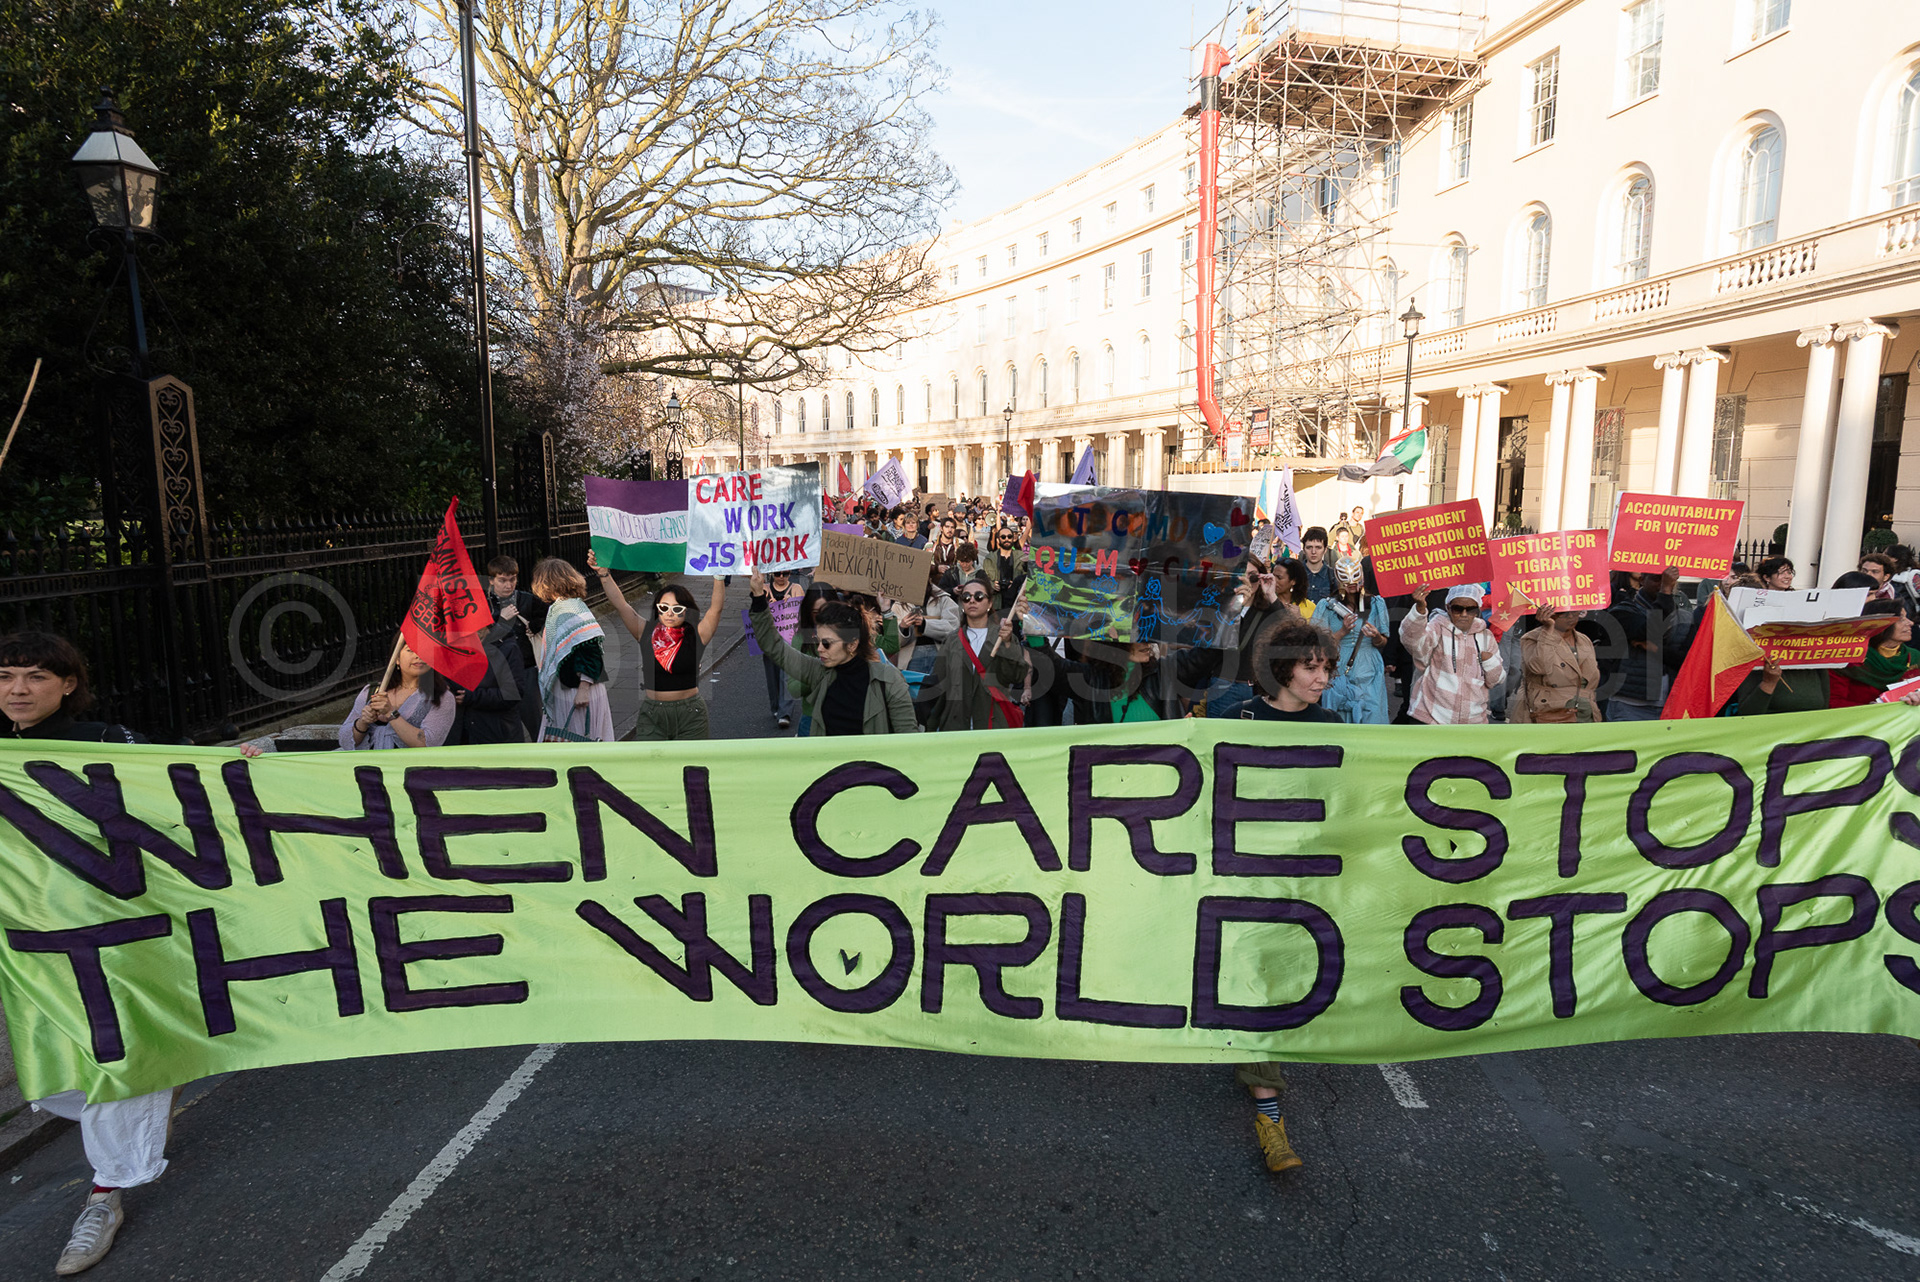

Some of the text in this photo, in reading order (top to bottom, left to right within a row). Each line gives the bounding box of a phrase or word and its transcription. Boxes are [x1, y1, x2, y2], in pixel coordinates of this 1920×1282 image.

[695, 473, 763, 504] CARE
[590, 508, 613, 536] STOP
[612, 511, 659, 540] VIOLENCE
[724, 501, 796, 534] WORK
[1380, 509, 1466, 538] INDEPENDENT
[1625, 502, 1736, 521] ACCOUNTABILITY
[1371, 525, 1483, 557] INVESTIGATION OF
[1634, 519, 1719, 537] FOR VICTIMS
[708, 533, 810, 568] IS WORK
[825, 533, 850, 555] today
[858, 539, 879, 561] fight
[883, 542, 897, 562] for
[898, 552, 915, 569] my
[1376, 542, 1487, 573] SEXUAL VIOLENCE
[1498, 533, 1597, 558] JUSTICE FOR
[1664, 538, 1683, 551] OF
[823, 551, 887, 580] MEXICAN
[1403, 563, 1465, 585] IN TIGRAY
[1515, 555, 1583, 575] TIGRAY'S
[1612, 550, 1729, 571] SEXUAL VIOLENCE
[1505, 574, 1594, 595] VICTIMS OF
[1546, 593, 1607, 608] VIOLENCE
[1770, 647, 1864, 661] BATTLEFIELD
[1772, 637, 1824, 648] WOMEN'S
[0, 759, 718, 899] WHEN
[789, 742, 1344, 878] CARE
[4, 894, 529, 1063] THE
[576, 891, 1345, 1032] WORLD
